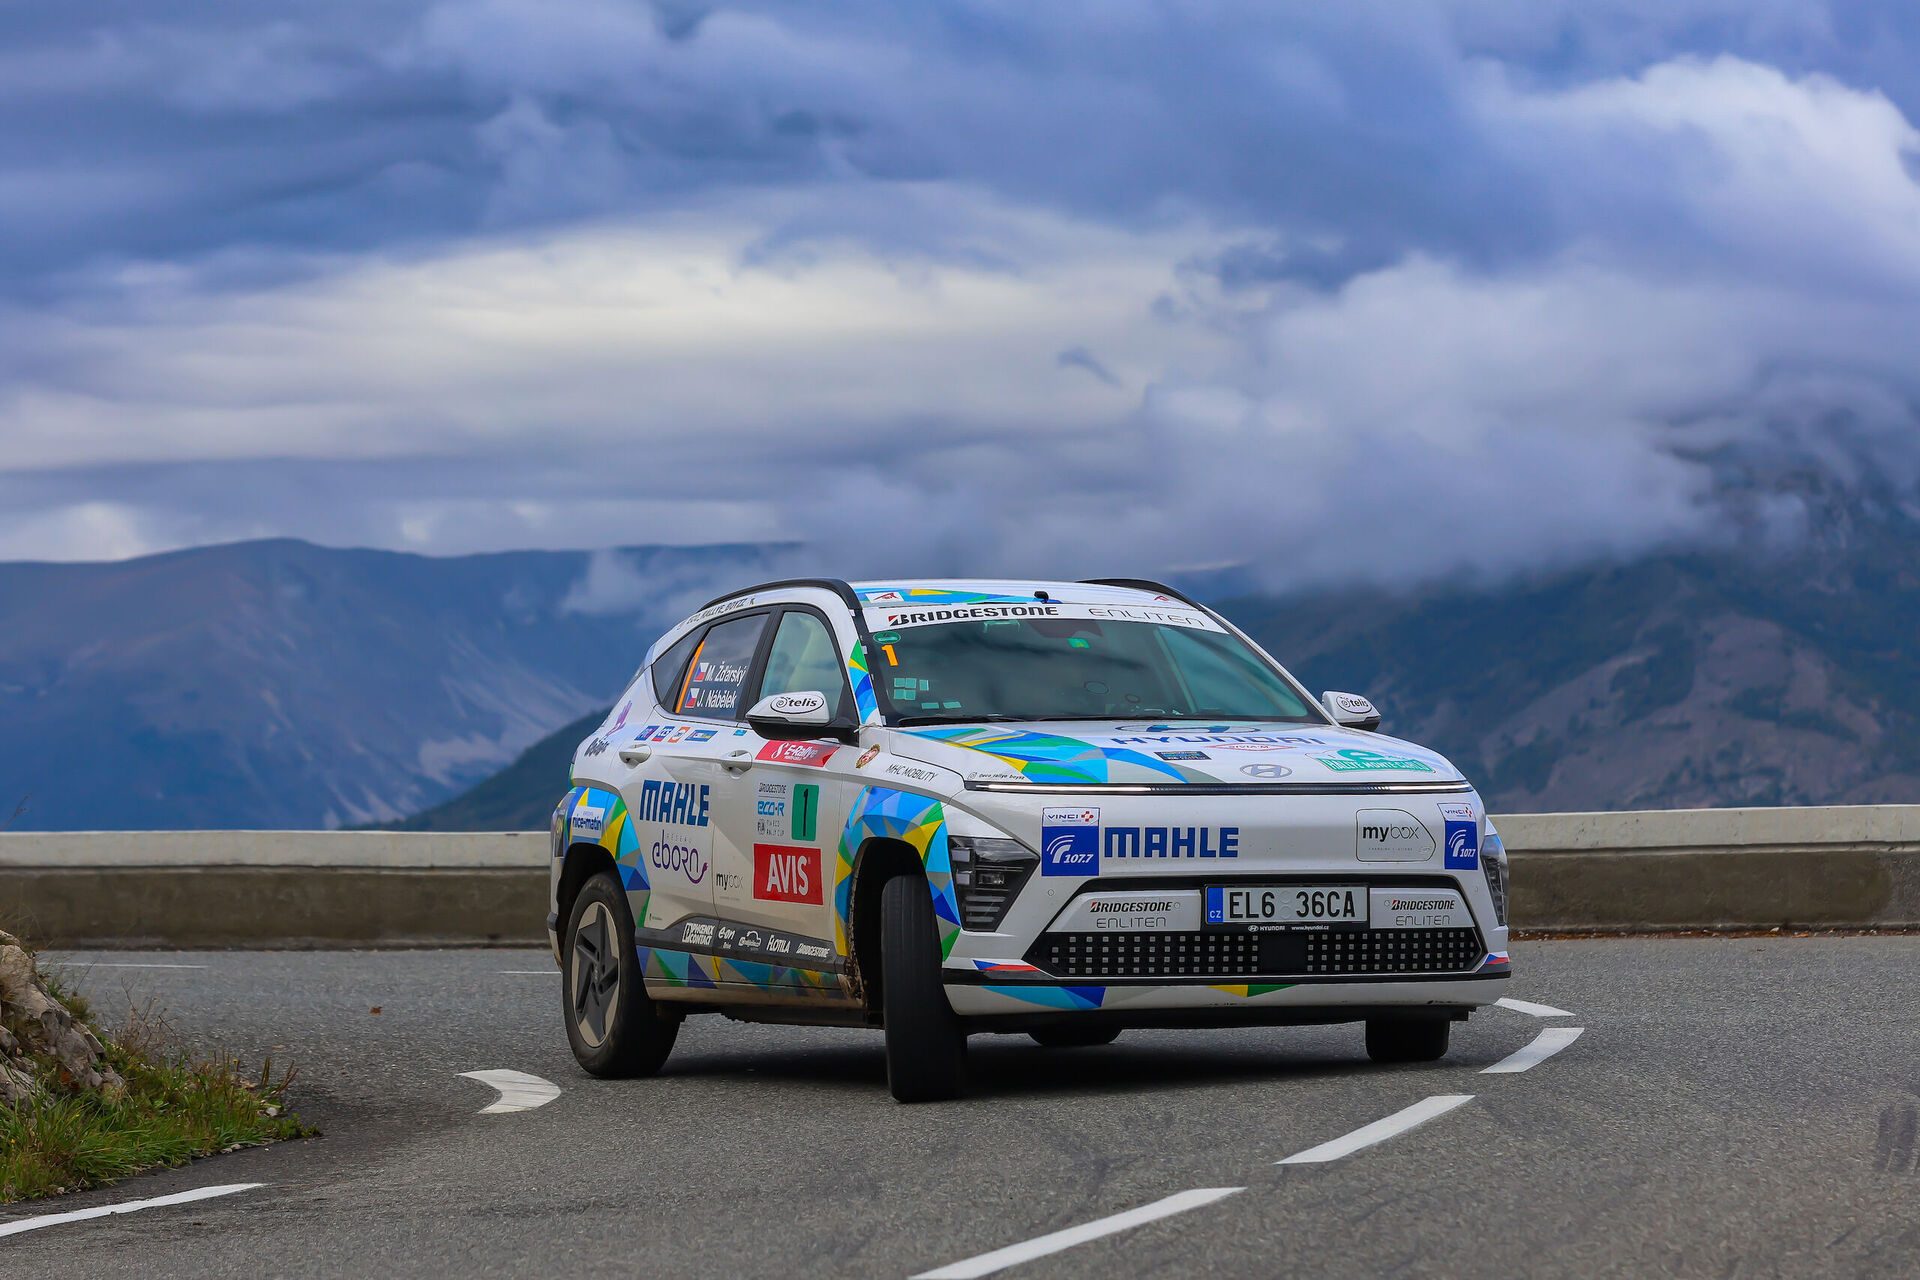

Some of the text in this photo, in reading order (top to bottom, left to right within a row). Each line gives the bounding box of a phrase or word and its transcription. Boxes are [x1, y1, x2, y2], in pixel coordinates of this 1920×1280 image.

[888, 606, 1060, 627] BRIDGESTONE
[1088, 608, 1205, 627] ENLITEN
[881, 643, 899, 667] 1
[704, 664, 716, 682] M.
[696, 689, 705, 708] J.
[788, 698, 817, 707] telis
[1350, 697, 1369, 708] telis
[1110, 735, 1326, 745] HYUNDAI
[783, 744, 819, 760] E-Rallye
[886, 763, 940, 783] MHC MOBILITY
[758, 782, 787, 794] BRIDGESTONE
[639, 779, 710, 827] MAHLE
[802, 788, 809, 837] 1
[572, 813, 601, 831] nice-matin
[1362, 823, 1419, 843] mybox
[1104, 826, 1240, 858] MAHLE
[1064, 853, 1095, 864] 107.7
[715, 871, 744, 891] mybox
[766, 853, 809, 896] AVIS
[1090, 901, 1173, 913] BRIDGESTONE
[1229, 890, 1356, 919] EL6 36CA
[1391, 899, 1455, 911] BRIDGESTONE
[1096, 917, 1167, 929] ENLITEN
[1209, 910, 1222, 919] CZ
[1395, 915, 1451, 926] ENLITEN
[690, 922, 716, 935] PHOENIX
[688, 933, 713, 946] CONTACT
[796, 942, 831, 958] BRIDGESTONE
